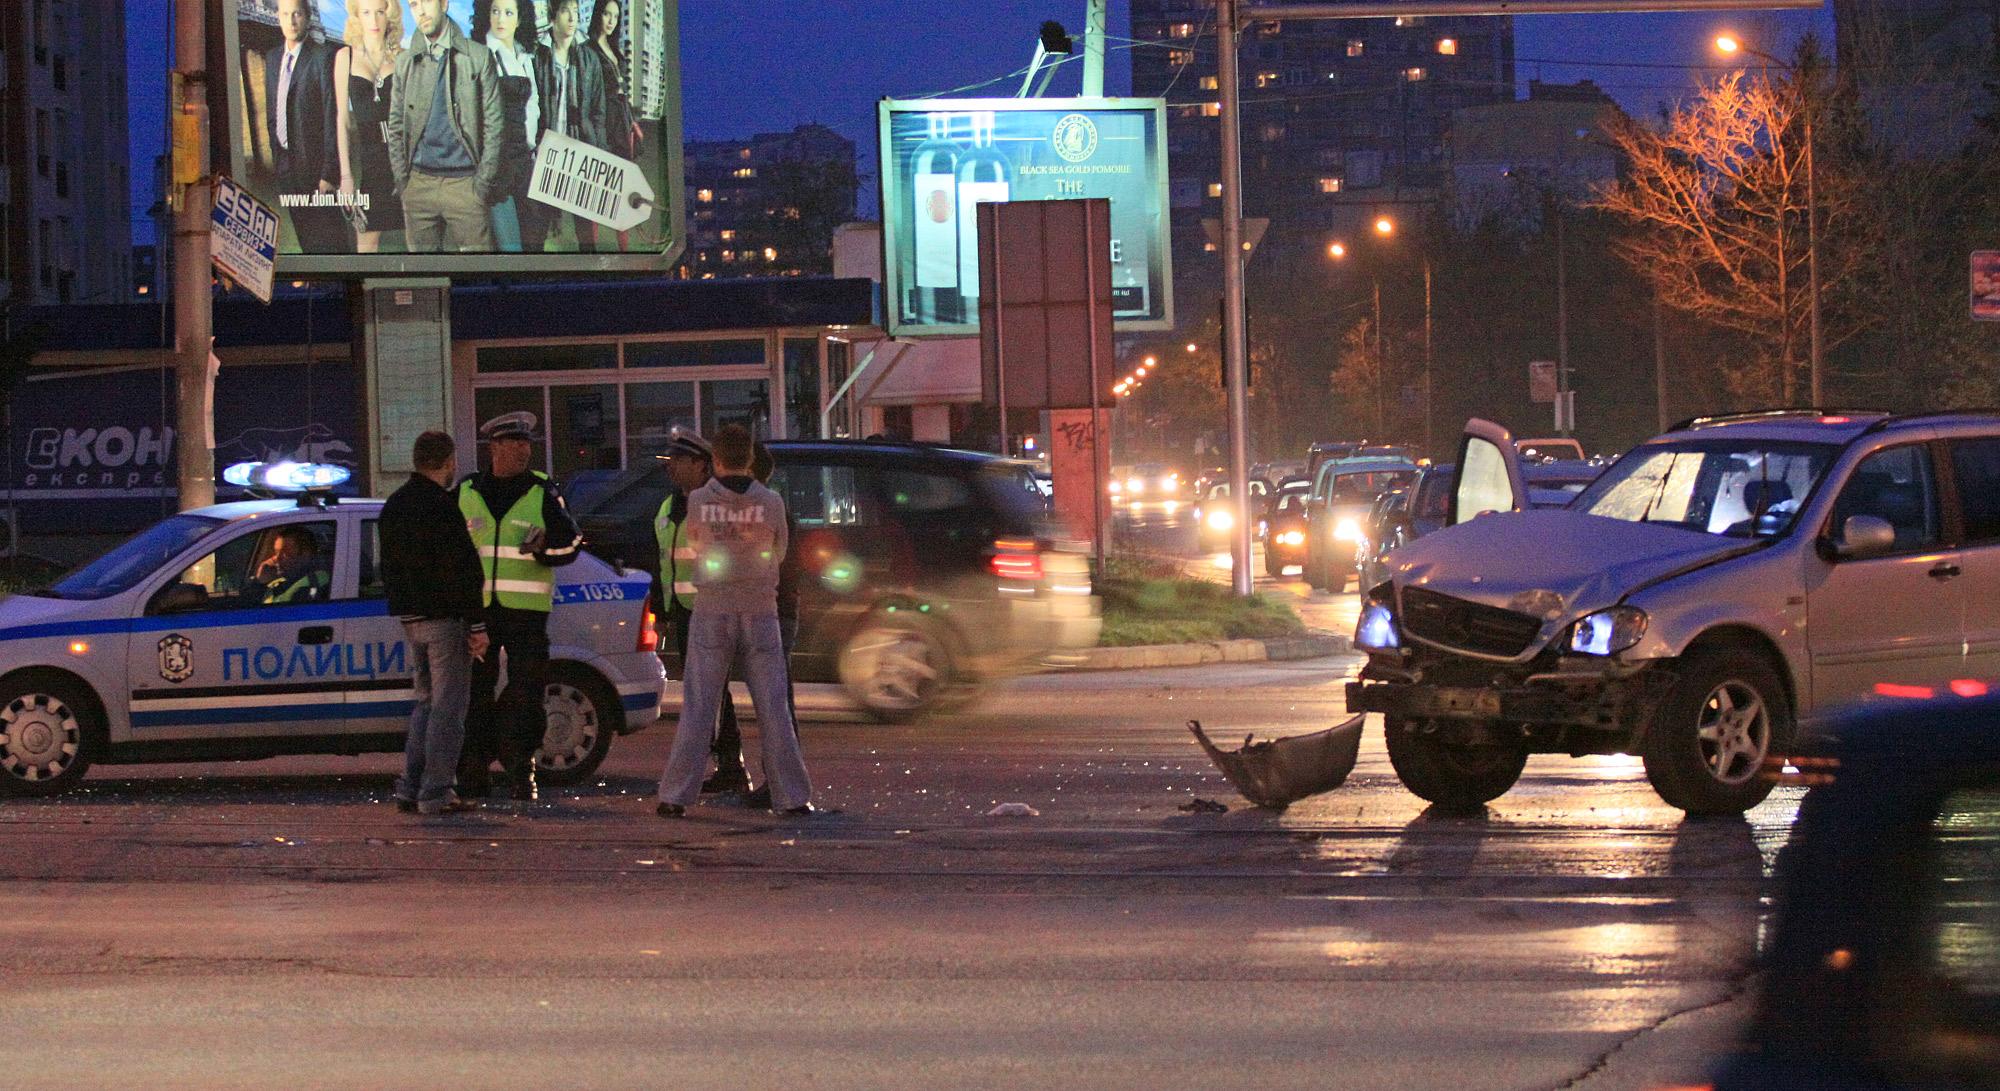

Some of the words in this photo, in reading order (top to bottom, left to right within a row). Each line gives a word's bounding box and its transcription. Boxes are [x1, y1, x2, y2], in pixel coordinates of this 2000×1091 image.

[562, 147, 576, 173] 11
[577, 154, 625, 193] АПРИЛ
[1020, 165, 1048, 175] BLACK
[1049, 165, 1064, 174] SEA
[1065, 165, 1090, 174] GOLD
[1055, 178, 1085, 193] THE
[279, 188, 370, 210] www.dom.btv.bg
[25, 426, 175, 469] ЕКОН
[25, 472, 165, 487] експре
[223, 640, 414, 681] ПОЛИЦИ
